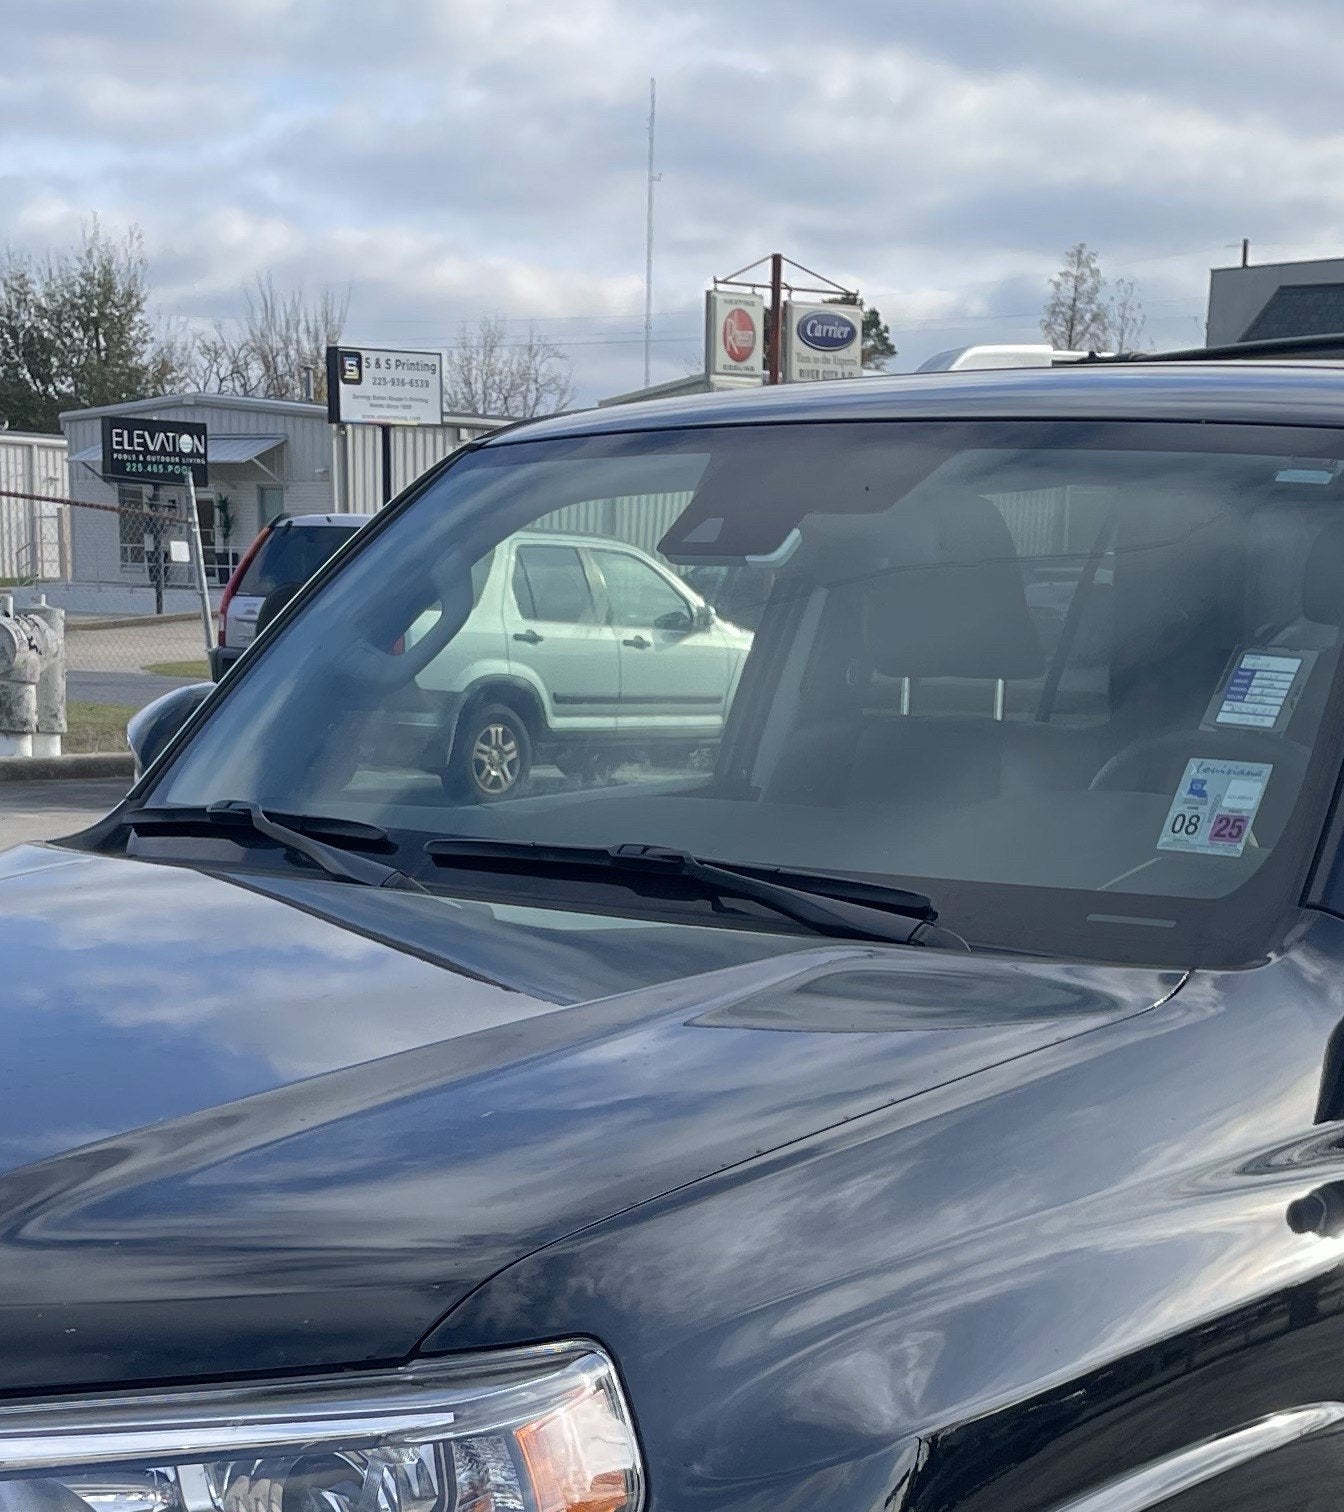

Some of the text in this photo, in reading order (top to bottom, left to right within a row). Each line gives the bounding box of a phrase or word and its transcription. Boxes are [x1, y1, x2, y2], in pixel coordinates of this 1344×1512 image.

[806, 319, 851, 339] Carrier
[365, 357, 437, 375] S & S Printing
[112, 428, 205, 454] ELEVATION
[1171, 813, 1244, 839] 08 25
